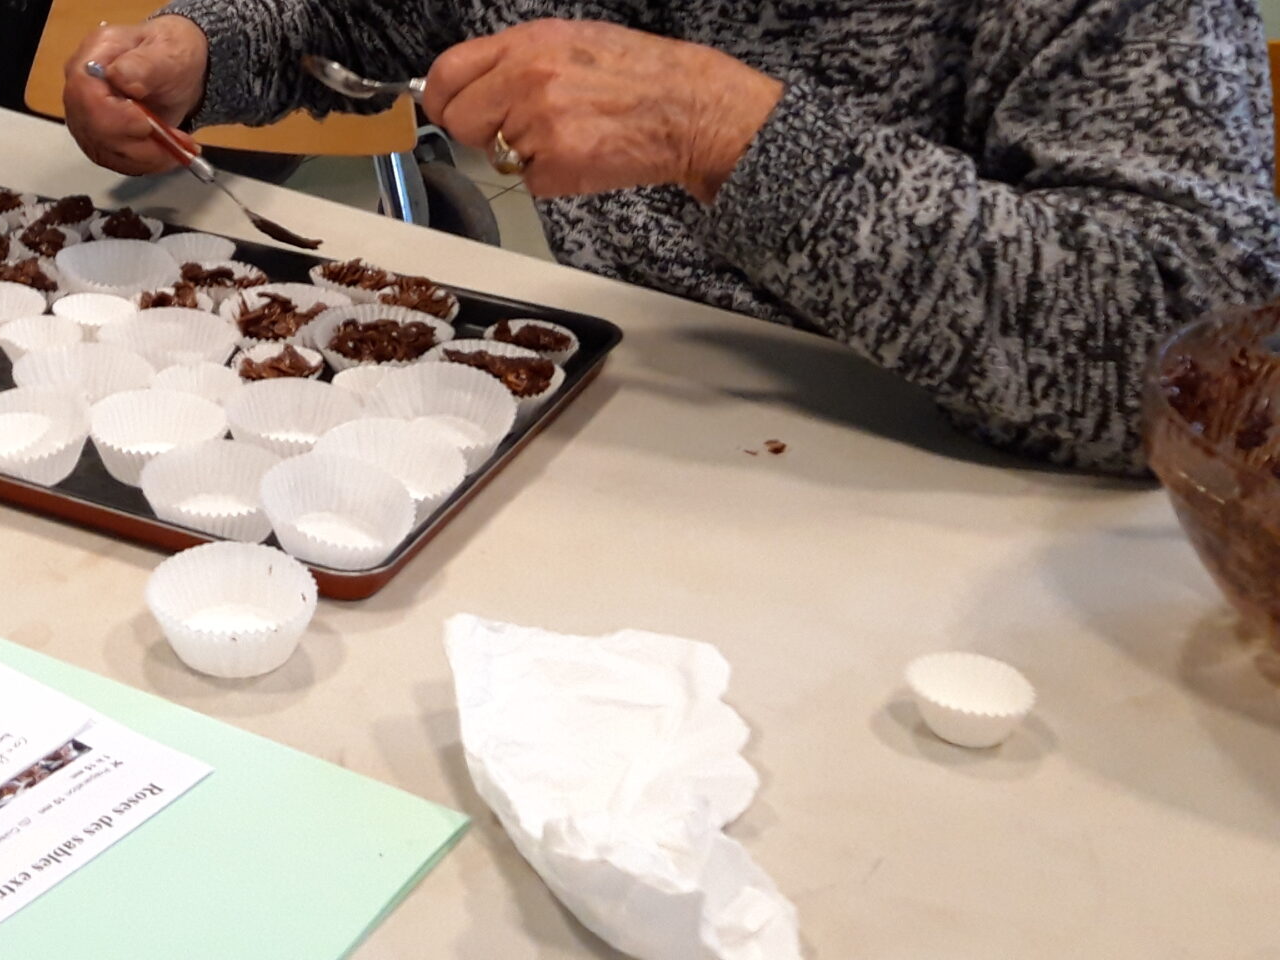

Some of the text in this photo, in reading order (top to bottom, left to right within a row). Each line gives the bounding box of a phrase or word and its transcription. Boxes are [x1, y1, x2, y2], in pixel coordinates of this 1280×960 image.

[111, 782, 164, 816] Roses
[82, 815, 113, 836] des
[31, 836, 85, 872] sables
